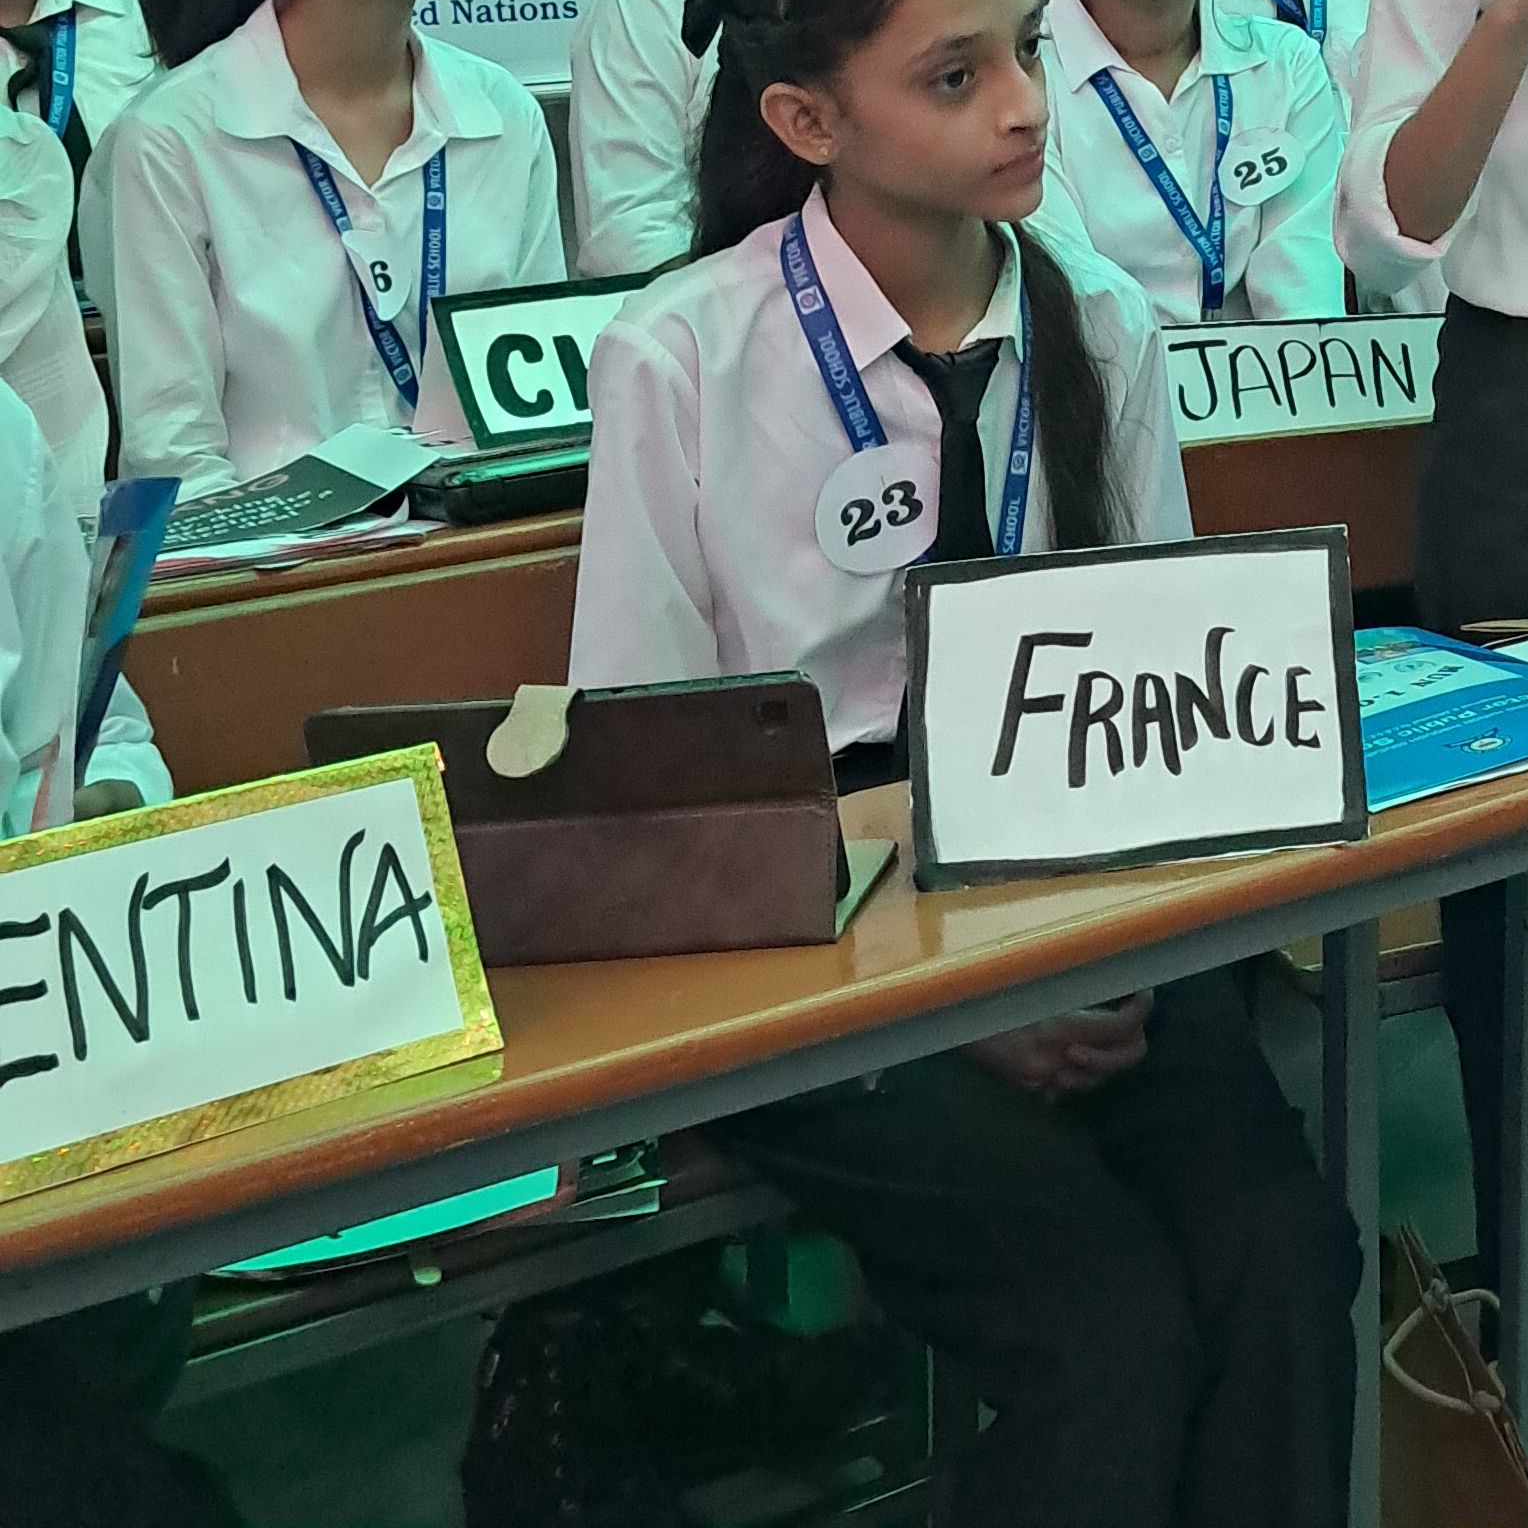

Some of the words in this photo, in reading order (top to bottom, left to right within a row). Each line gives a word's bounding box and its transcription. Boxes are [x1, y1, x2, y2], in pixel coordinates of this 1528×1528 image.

[1233, 146, 1288, 191] 25
[427, 227, 442, 271] SCHOOL
[817, 329, 852, 390] SCHOOL
[1167, 337, 1417, 421] JAPAN
[840, 479, 924, 548] 23
[1002, 496, 1022, 554] SCHOOL
[990, 625, 1328, 791] FRANCE
[1399, 707, 1478, 738] Public
